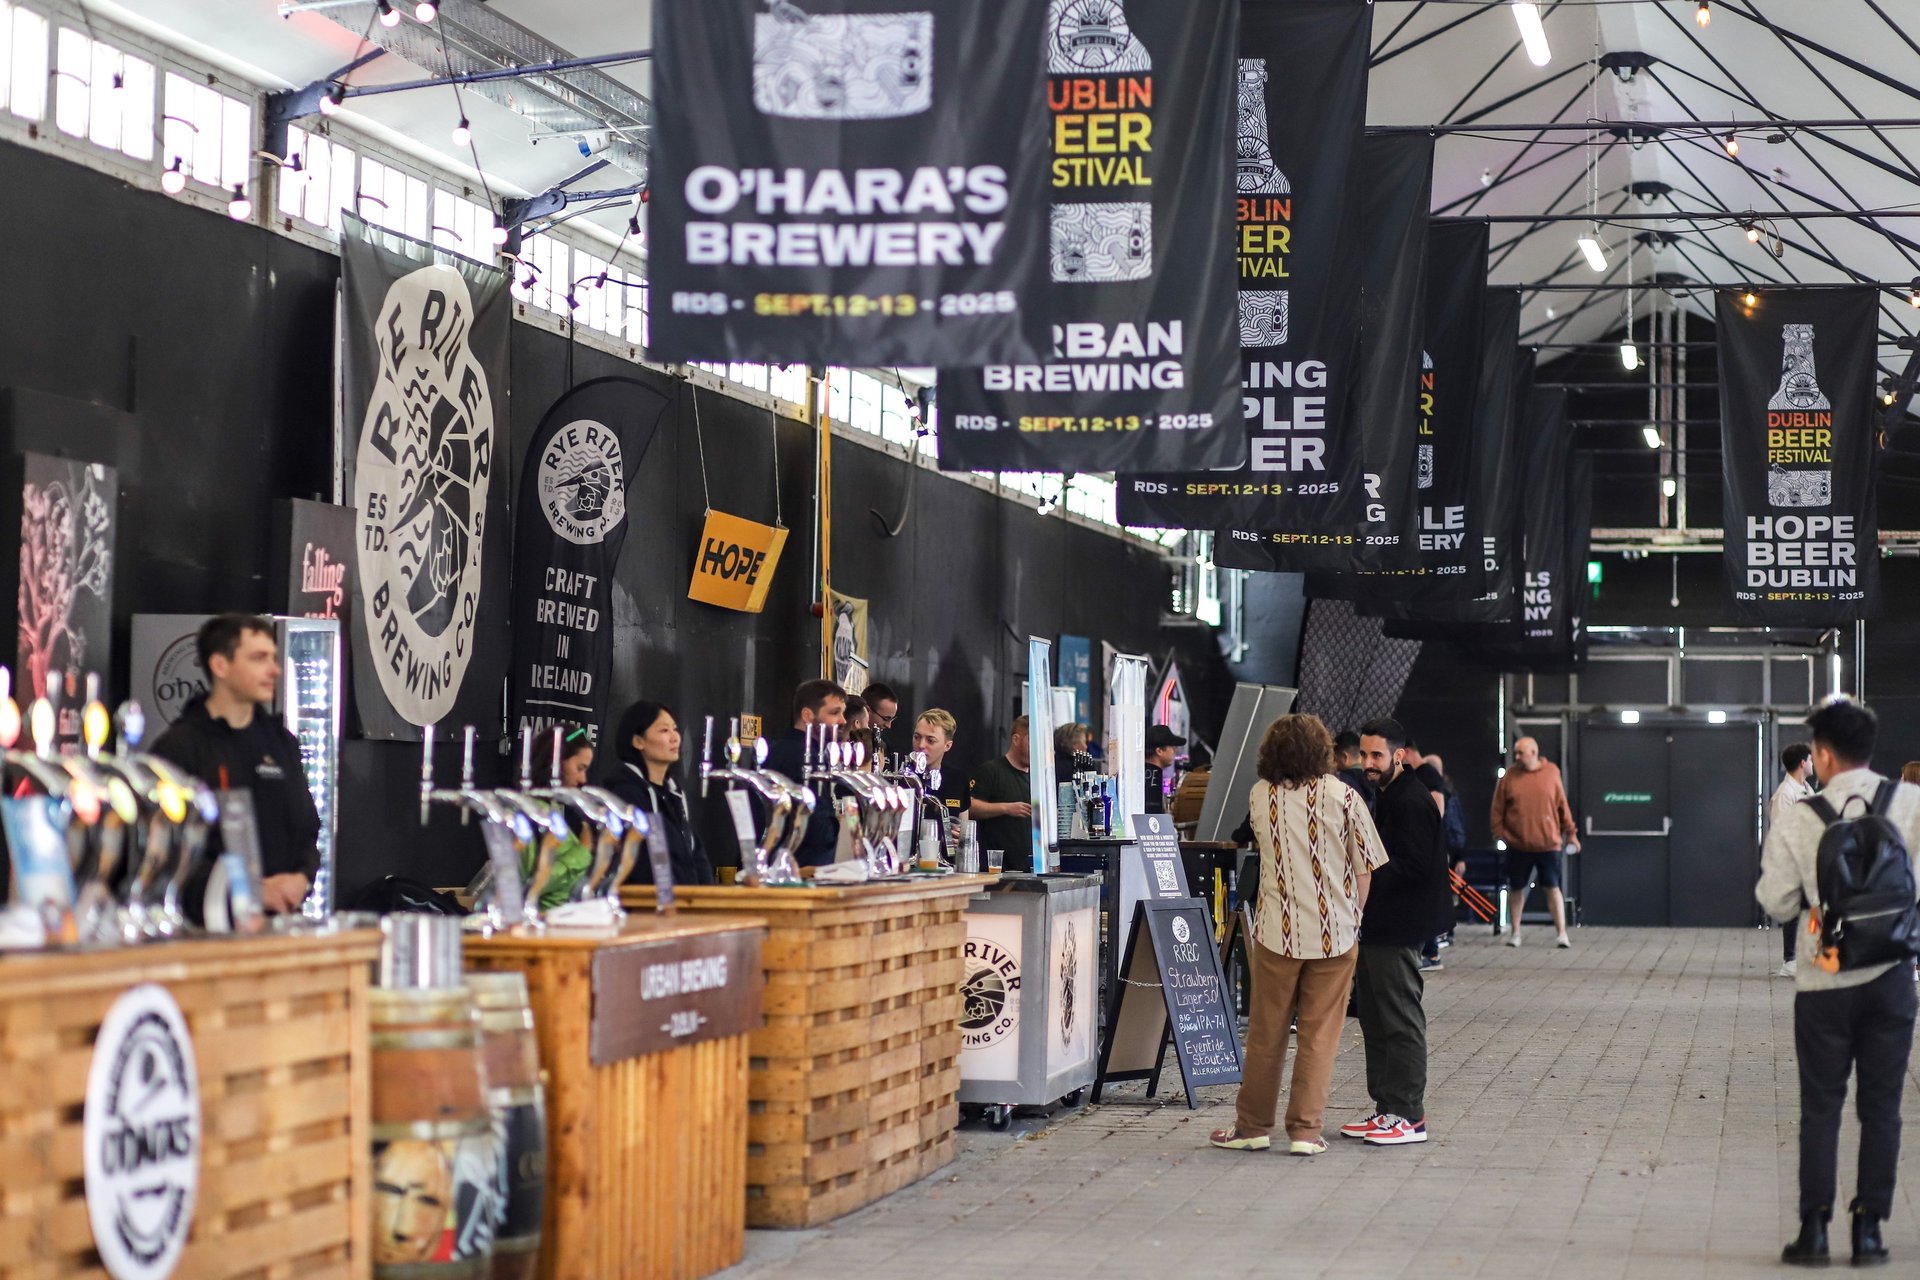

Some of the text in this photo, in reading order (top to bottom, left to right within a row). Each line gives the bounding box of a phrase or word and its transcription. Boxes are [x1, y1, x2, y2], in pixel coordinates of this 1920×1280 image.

[1047, 77, 1152, 110] UBLIN
[1054, 112, 1152, 154] EER
[1052, 156, 1152, 187] STIVAL
[684, 165, 1009, 215] O'HARA'S
[1237, 198, 1291, 221] BLIN
[685, 221, 1006, 267] BREWERY
[672, 292, 729, 315] RDS
[754, 293, 917, 317] SEPT.12-13
[940, 291, 1017, 315] 2025
[1052, 320, 1183, 358] BAN
[983, 361, 1184, 391] BREWING
[955, 415, 998, 431] RDS
[1018, 416, 1141, 432] SEPT.12-13
[1159, 413, 1214, 430] 2025
[1768, 412, 1831, 427] DUBLIN
[1768, 429, 1831, 447] BEER
[545, 426, 624, 493] RYE RIVER
[1768, 449, 1831, 463] FESTIVAL
[1134, 480, 1168, 493] RDS
[1186, 484, 1282, 495] SEPT.12-13
[1298, 483, 1339, 495] 2025
[548, 500, 595, 538] BREWING
[1747, 515, 1855, 540] HOPE
[1232, 530, 1258, 541] RDS
[1272, 533, 1352, 545] SEPT.12-13
[1366, 535, 1400, 545] 2025
[701, 537, 766, 585] HOPE
[1747, 542, 1856, 566] BEER
[545, 566, 597, 599] CRAFT
[1436, 565, 1466, 575] 2025
[1747, 569, 1856, 587] DUBLIN
[1736, 592, 1756, 600] RDS
[1839, 591, 1864, 600] 2025
[536, 598, 600, 633] BREWED
[373, 579, 450, 700] BREWING
[556, 634, 570, 660] IN
[531, 664, 592, 696] IRELAND
[1173, 943, 1200, 962] RRBC
[964, 942, 1021, 992] RIVER
[1168, 966, 1219, 992] Strawberry
[1175, 991, 1201, 1013] Lager
[1185, 1039, 1226, 1055] Eventide
